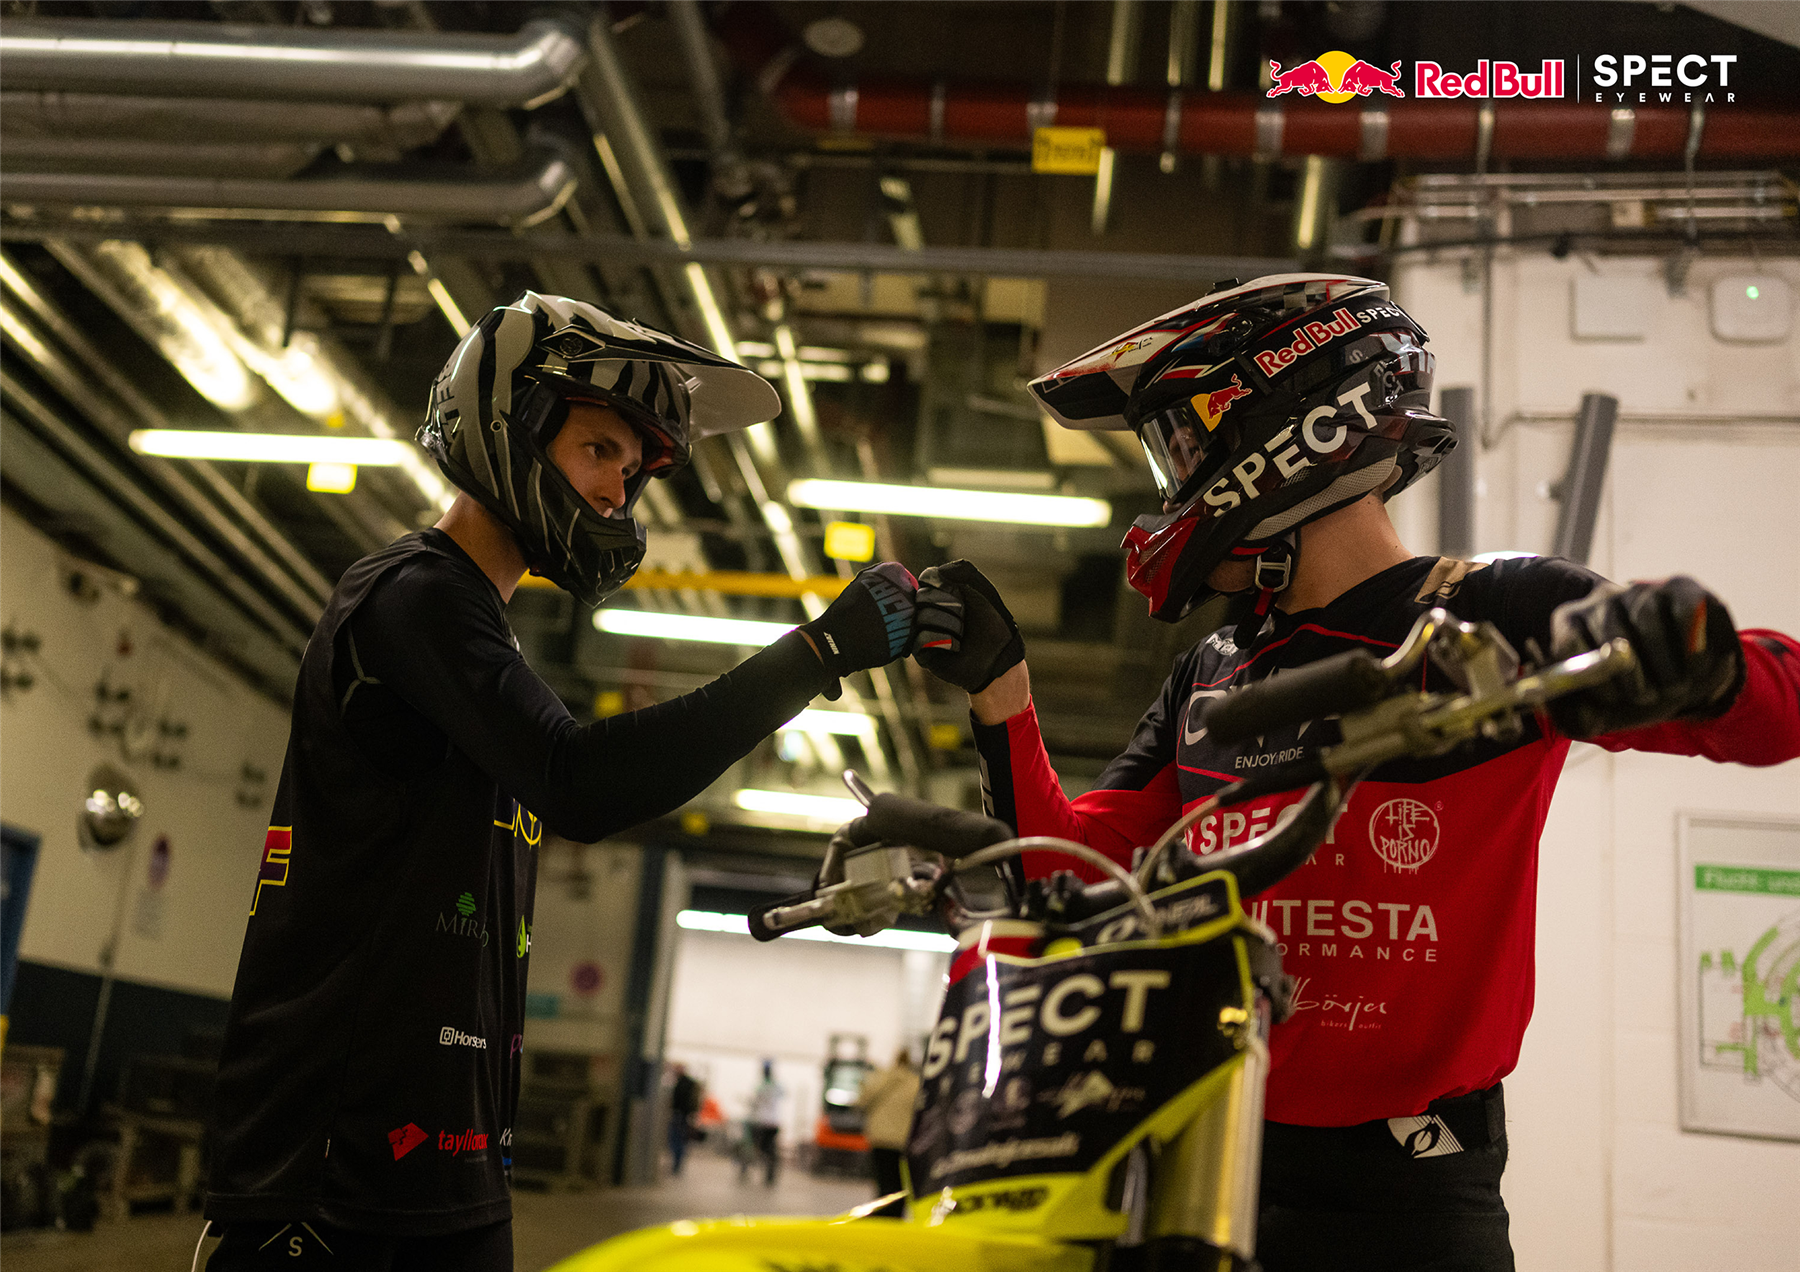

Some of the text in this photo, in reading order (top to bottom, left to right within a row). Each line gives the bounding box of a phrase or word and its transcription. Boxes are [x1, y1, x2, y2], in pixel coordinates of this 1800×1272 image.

[1356, 306, 1401, 324] SPEC
[1203, 381, 1378, 518] SPECT
[1235, 752, 1278, 769] ENJOY
[1279, 746, 1304, 764] RIDE
[1380, 835, 1430, 865] PORNO
[922, 970, 1172, 1080] SPECT
